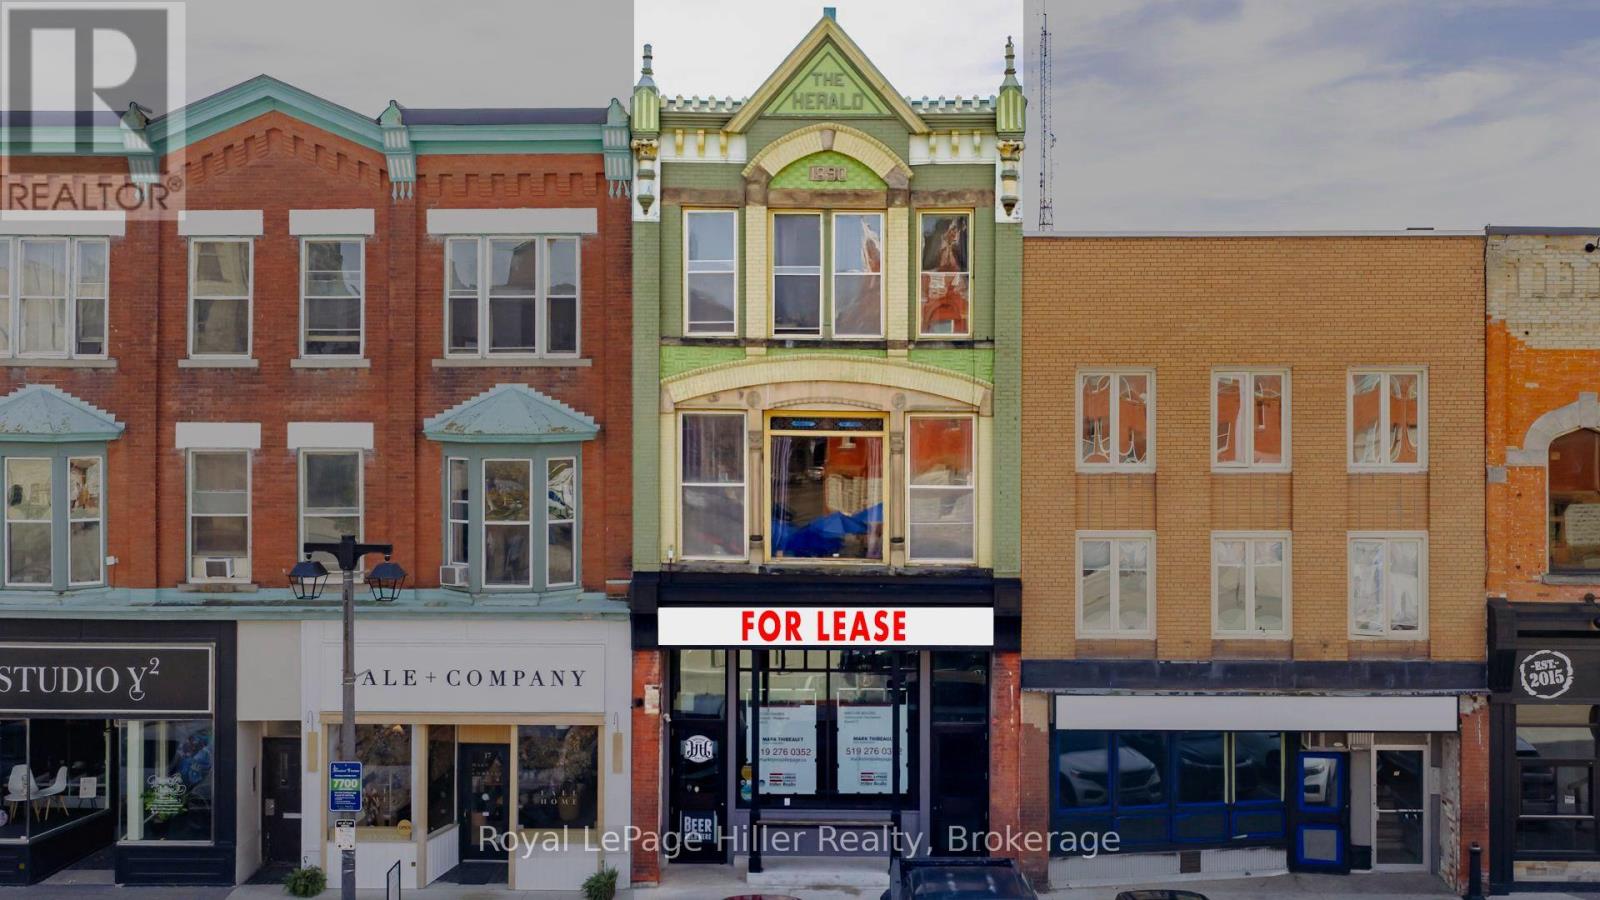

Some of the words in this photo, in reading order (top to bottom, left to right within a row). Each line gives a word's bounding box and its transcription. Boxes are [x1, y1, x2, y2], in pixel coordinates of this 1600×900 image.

[812, 72, 846, 87] THE
[792, 92, 864, 110] HERALD
[808, 165, 848, 181] 1890
[741, 610, 803, 642] FOR
[817, 610, 907, 642] LEASE
[0, 665, 120, 694] STUDIO
[341, 669, 417, 686] ALE
[446, 669, 587, 687] COMPANY
[1529, 669, 1565, 687] 2015
[761, 748, 771, 756] 19
[772, 748, 788, 756] 276
[790, 748, 812, 756] 0352
[846, 747, 861, 755] 519
[864, 747, 879, 755] 276
[333, 779, 358, 788] 7700
[684, 816, 712, 832] BEER
